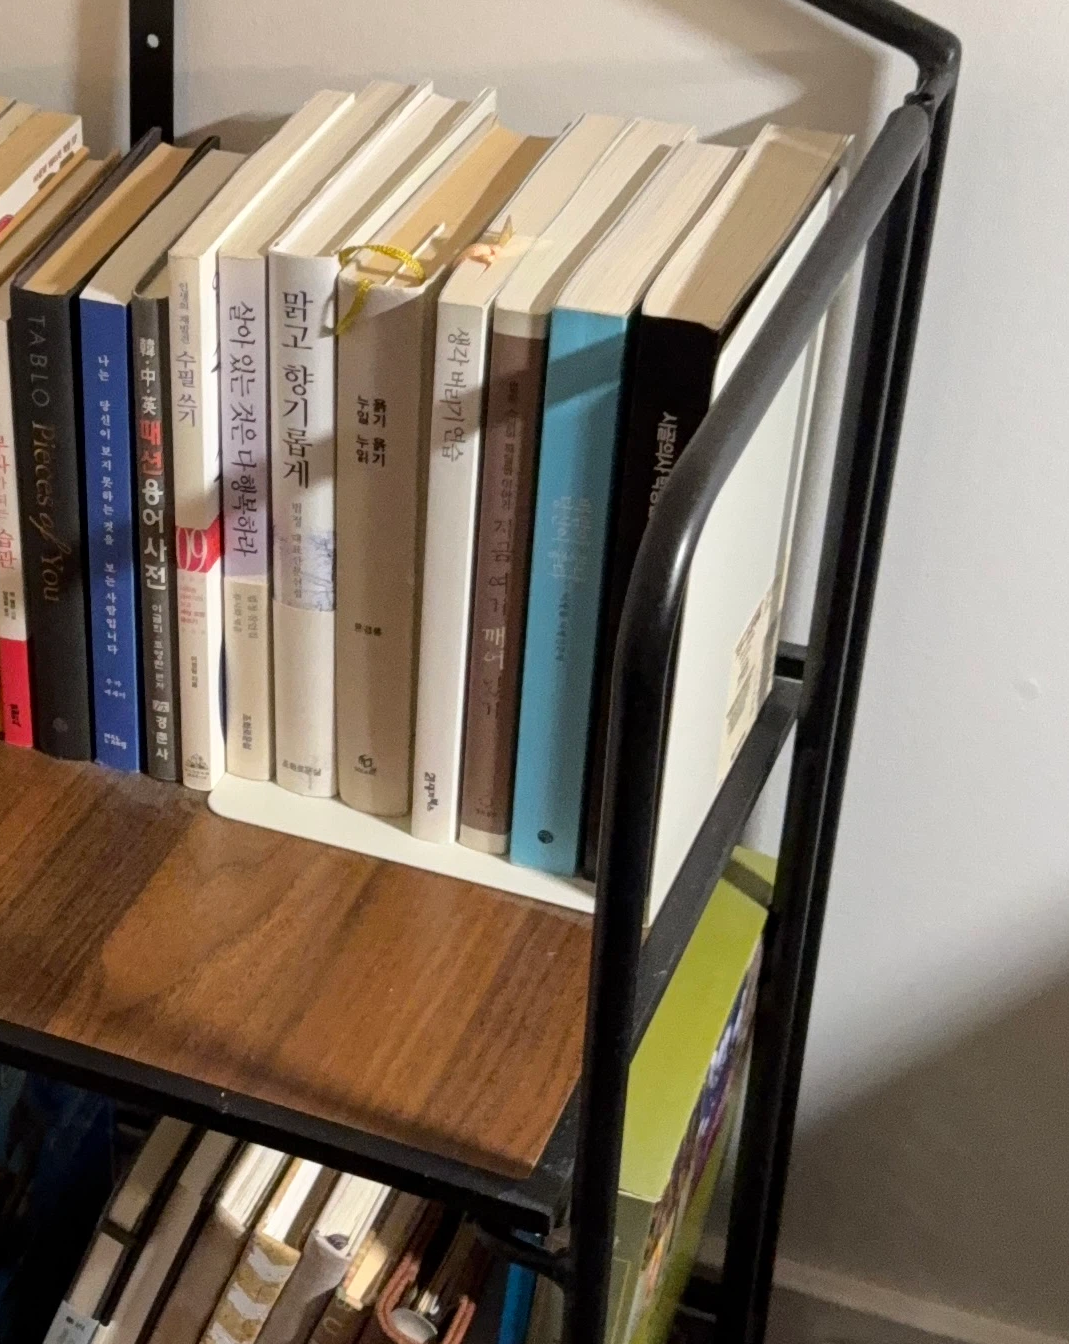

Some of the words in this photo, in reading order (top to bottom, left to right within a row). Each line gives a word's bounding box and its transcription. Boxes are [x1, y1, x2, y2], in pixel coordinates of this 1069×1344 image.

[229, 300, 257, 348] 살아
[281, 290, 314, 350] 맑고
[26, 315, 51, 408] TABLO
[447, 327, 472, 367] 생각
[97, 355, 110, 382] 나는
[174, 351, 198, 389] 수필
[229, 354, 257, 397] 있는
[177, 394, 198, 428] 쓰기
[438, 370, 468, 423] 버리기
[98, 399, 113, 441] 당신이
[230, 402, 258, 443] 것은
[281, 364, 315, 490] 향기롭게
[31, 420, 56, 507] Pieces
[100, 446, 113, 472] 보지
[440, 423, 466, 464] 연습
[100, 476, 115, 516] 못하는
[231, 474, 260, 559] 행복하라
[102, 520, 116, 546] 것을
[40, 555, 63, 603] You
[103, 562, 117, 588] 보는
[104, 592, 120, 656] 사람입니다
